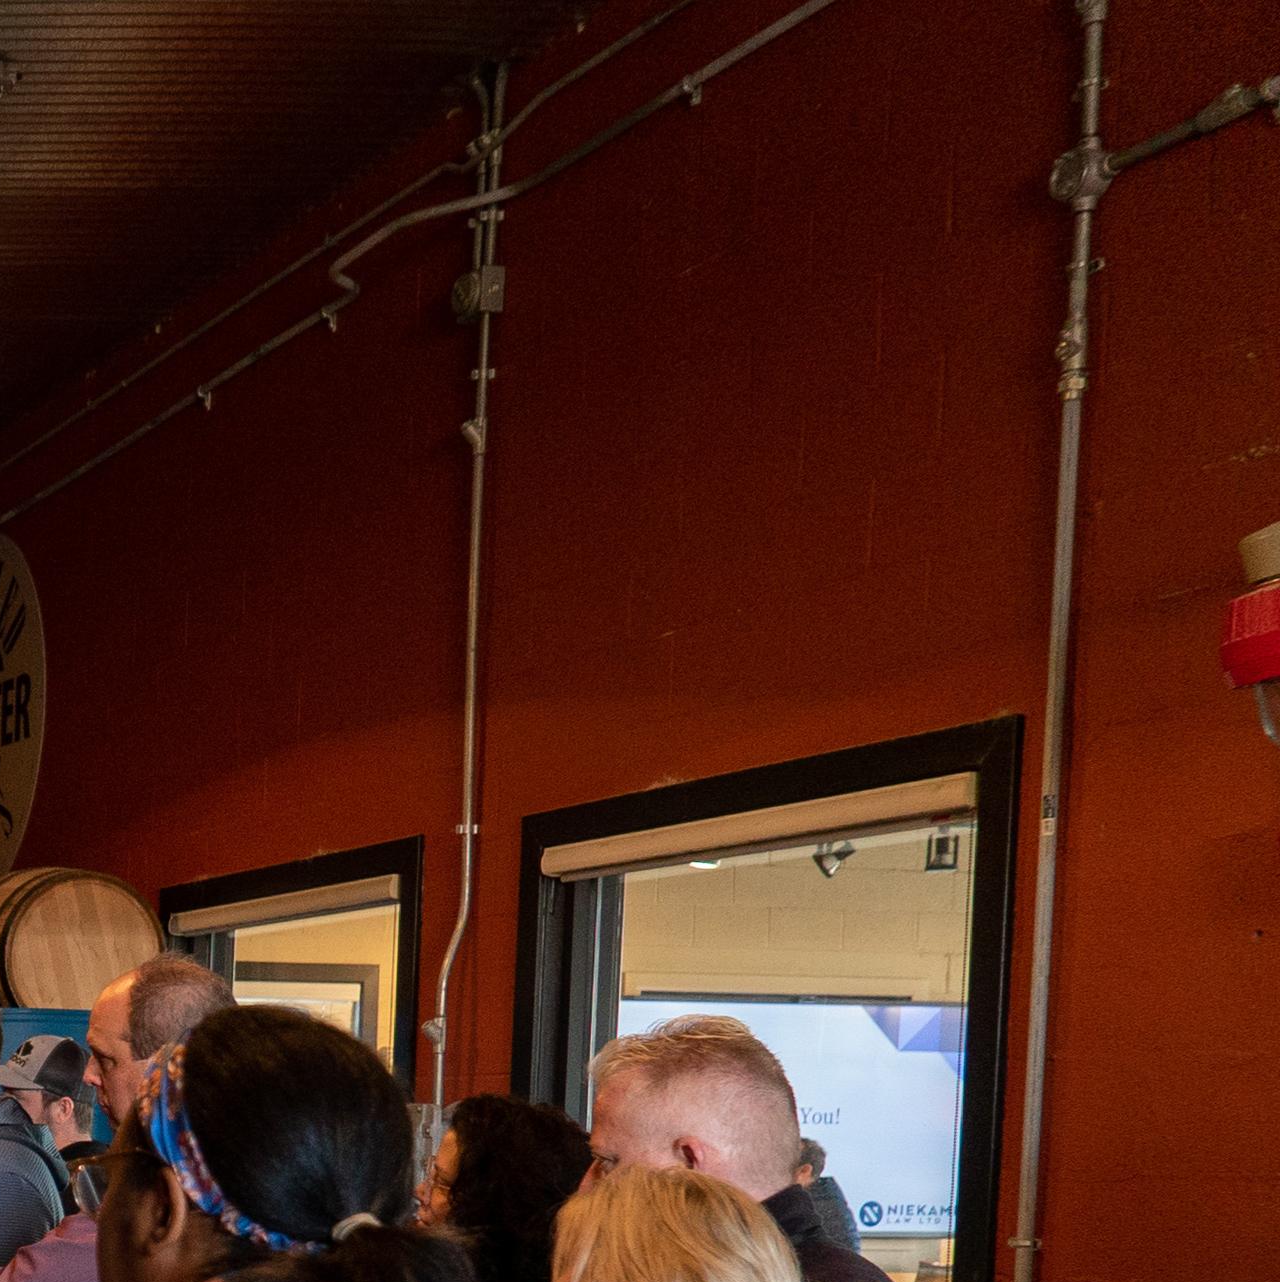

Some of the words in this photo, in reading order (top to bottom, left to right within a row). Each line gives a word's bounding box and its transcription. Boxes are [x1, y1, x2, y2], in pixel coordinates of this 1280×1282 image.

[800, 1107, 841, 1125] You!
[887, 1204, 957, 1217] NIEKAM
[887, 1217, 911, 1225] LAW
[919, 1217, 941, 1225] LTD
